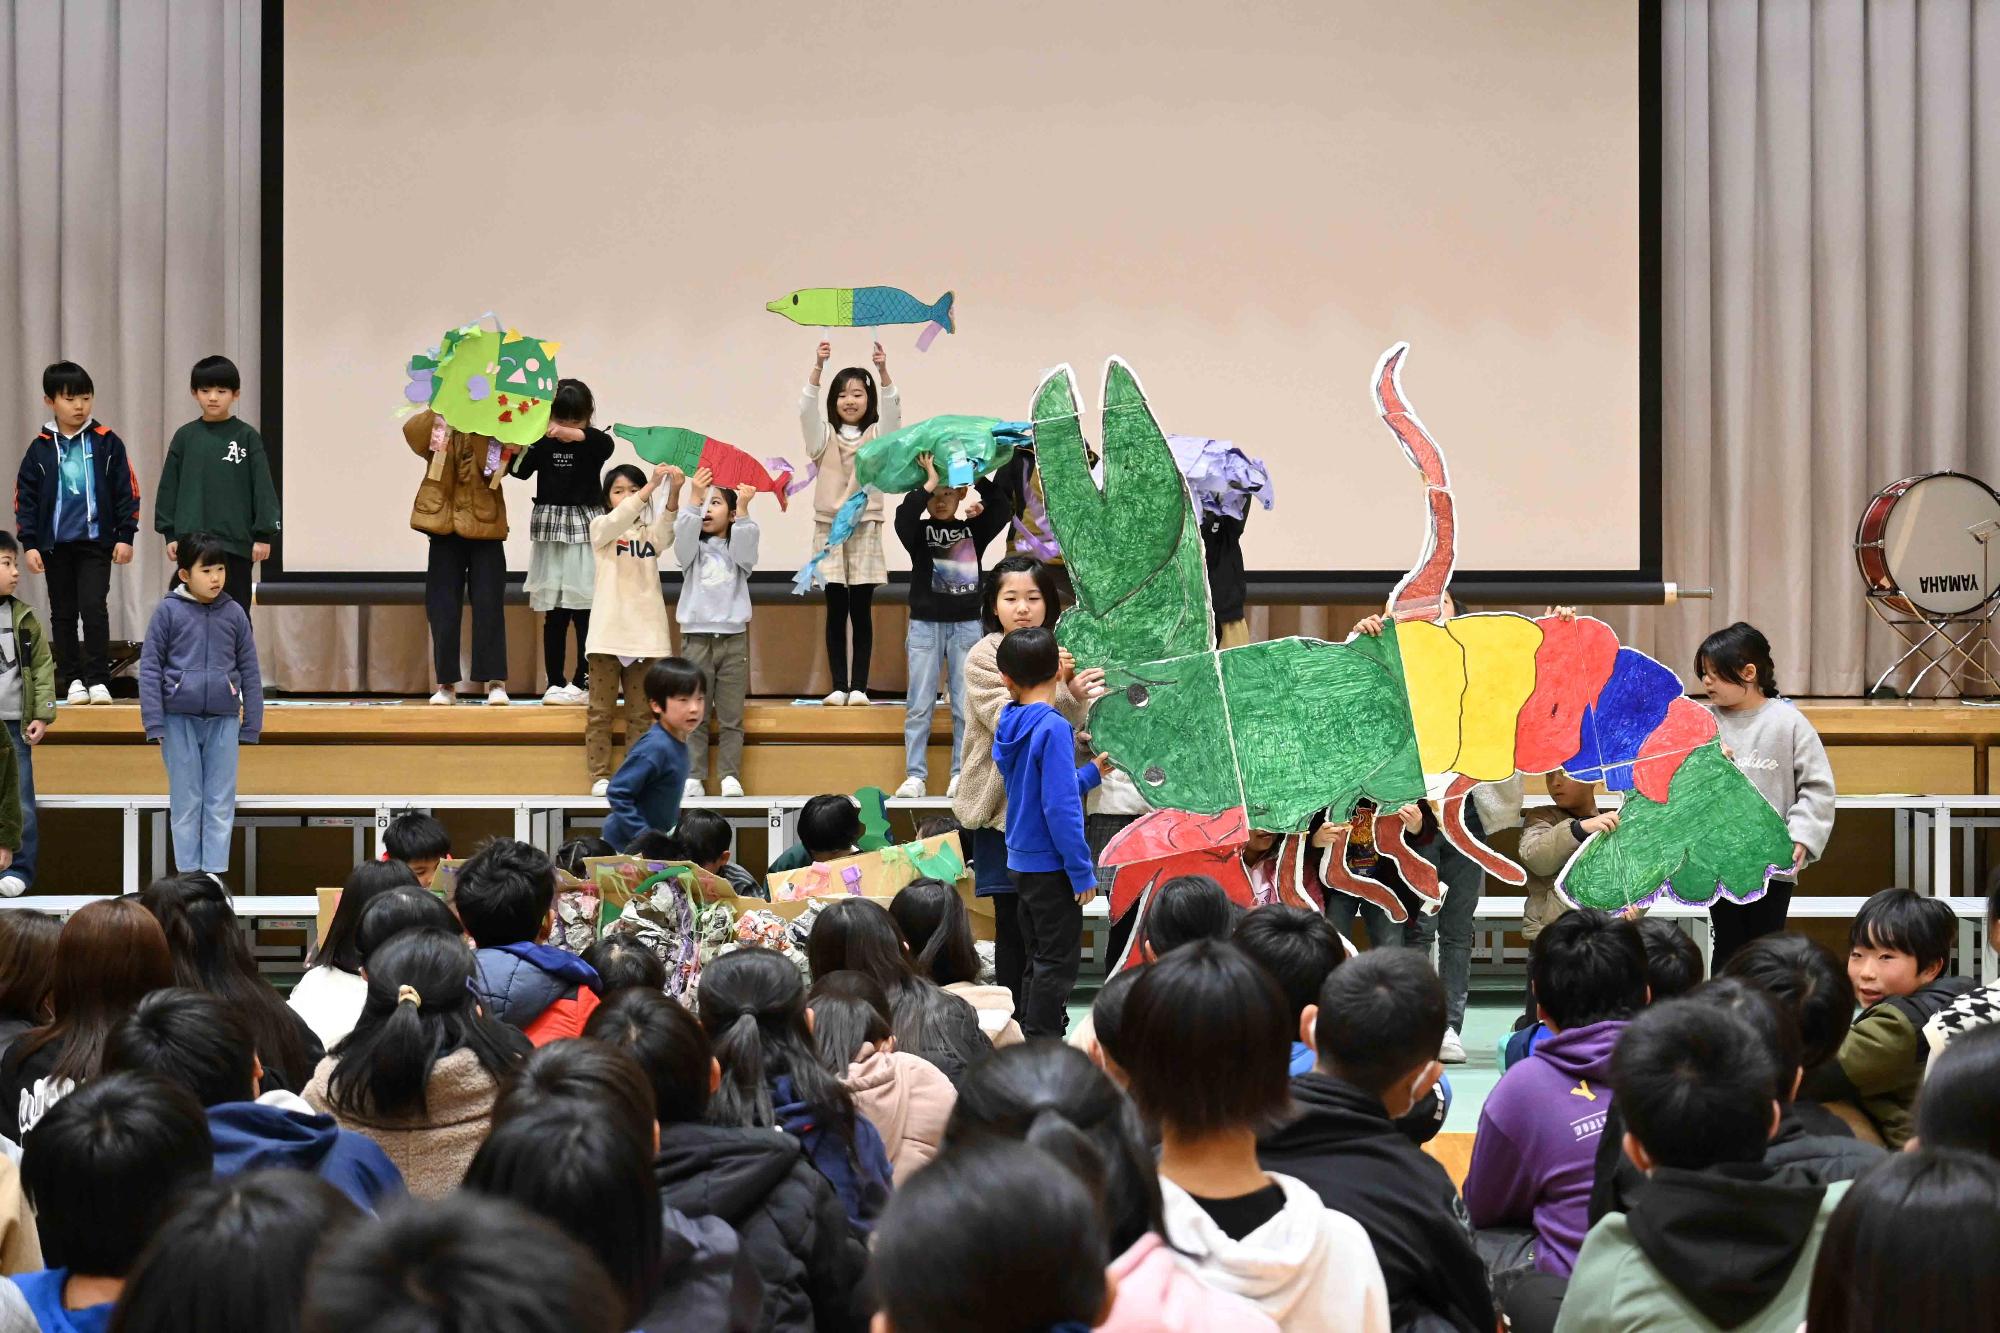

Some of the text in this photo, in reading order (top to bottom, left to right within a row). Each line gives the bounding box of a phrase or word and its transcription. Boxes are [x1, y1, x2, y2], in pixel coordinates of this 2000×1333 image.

[222, 441, 247, 464] A's
[925, 525, 973, 544] NASA
[616, 539, 656, 558] FILA
[1919, 574, 1979, 593] YAMAHA
[1570, 1080, 1597, 1101] Y
